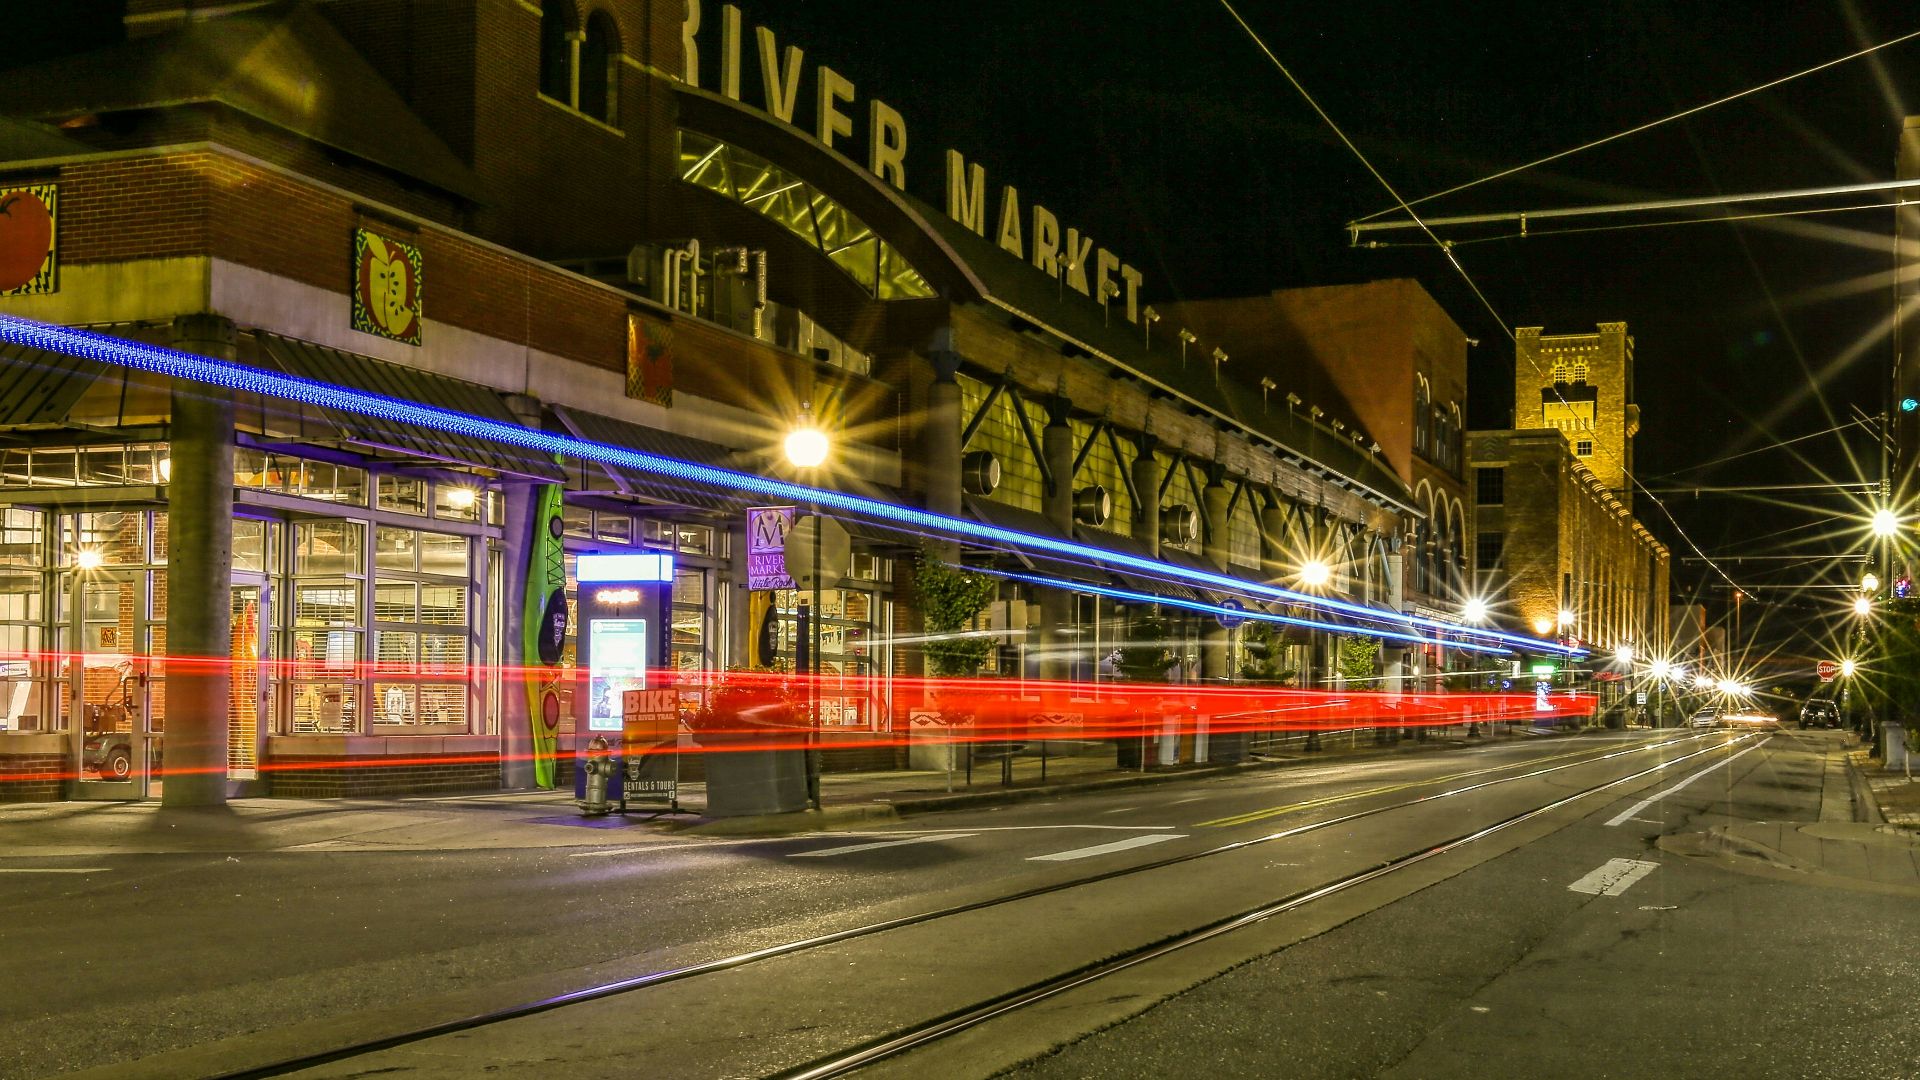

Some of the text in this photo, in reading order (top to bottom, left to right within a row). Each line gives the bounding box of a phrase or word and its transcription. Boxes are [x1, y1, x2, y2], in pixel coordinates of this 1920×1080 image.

[947, 149, 1142, 324] MARKET
[755, 554, 785, 565] RIVER
[750, 564, 786, 575] MARKE
[1819, 665, 1835, 673] STOP
[625, 690, 676, 713] BIKE
[623, 781, 649, 791] RENTALS
[656, 780, 675, 790] TOURS
